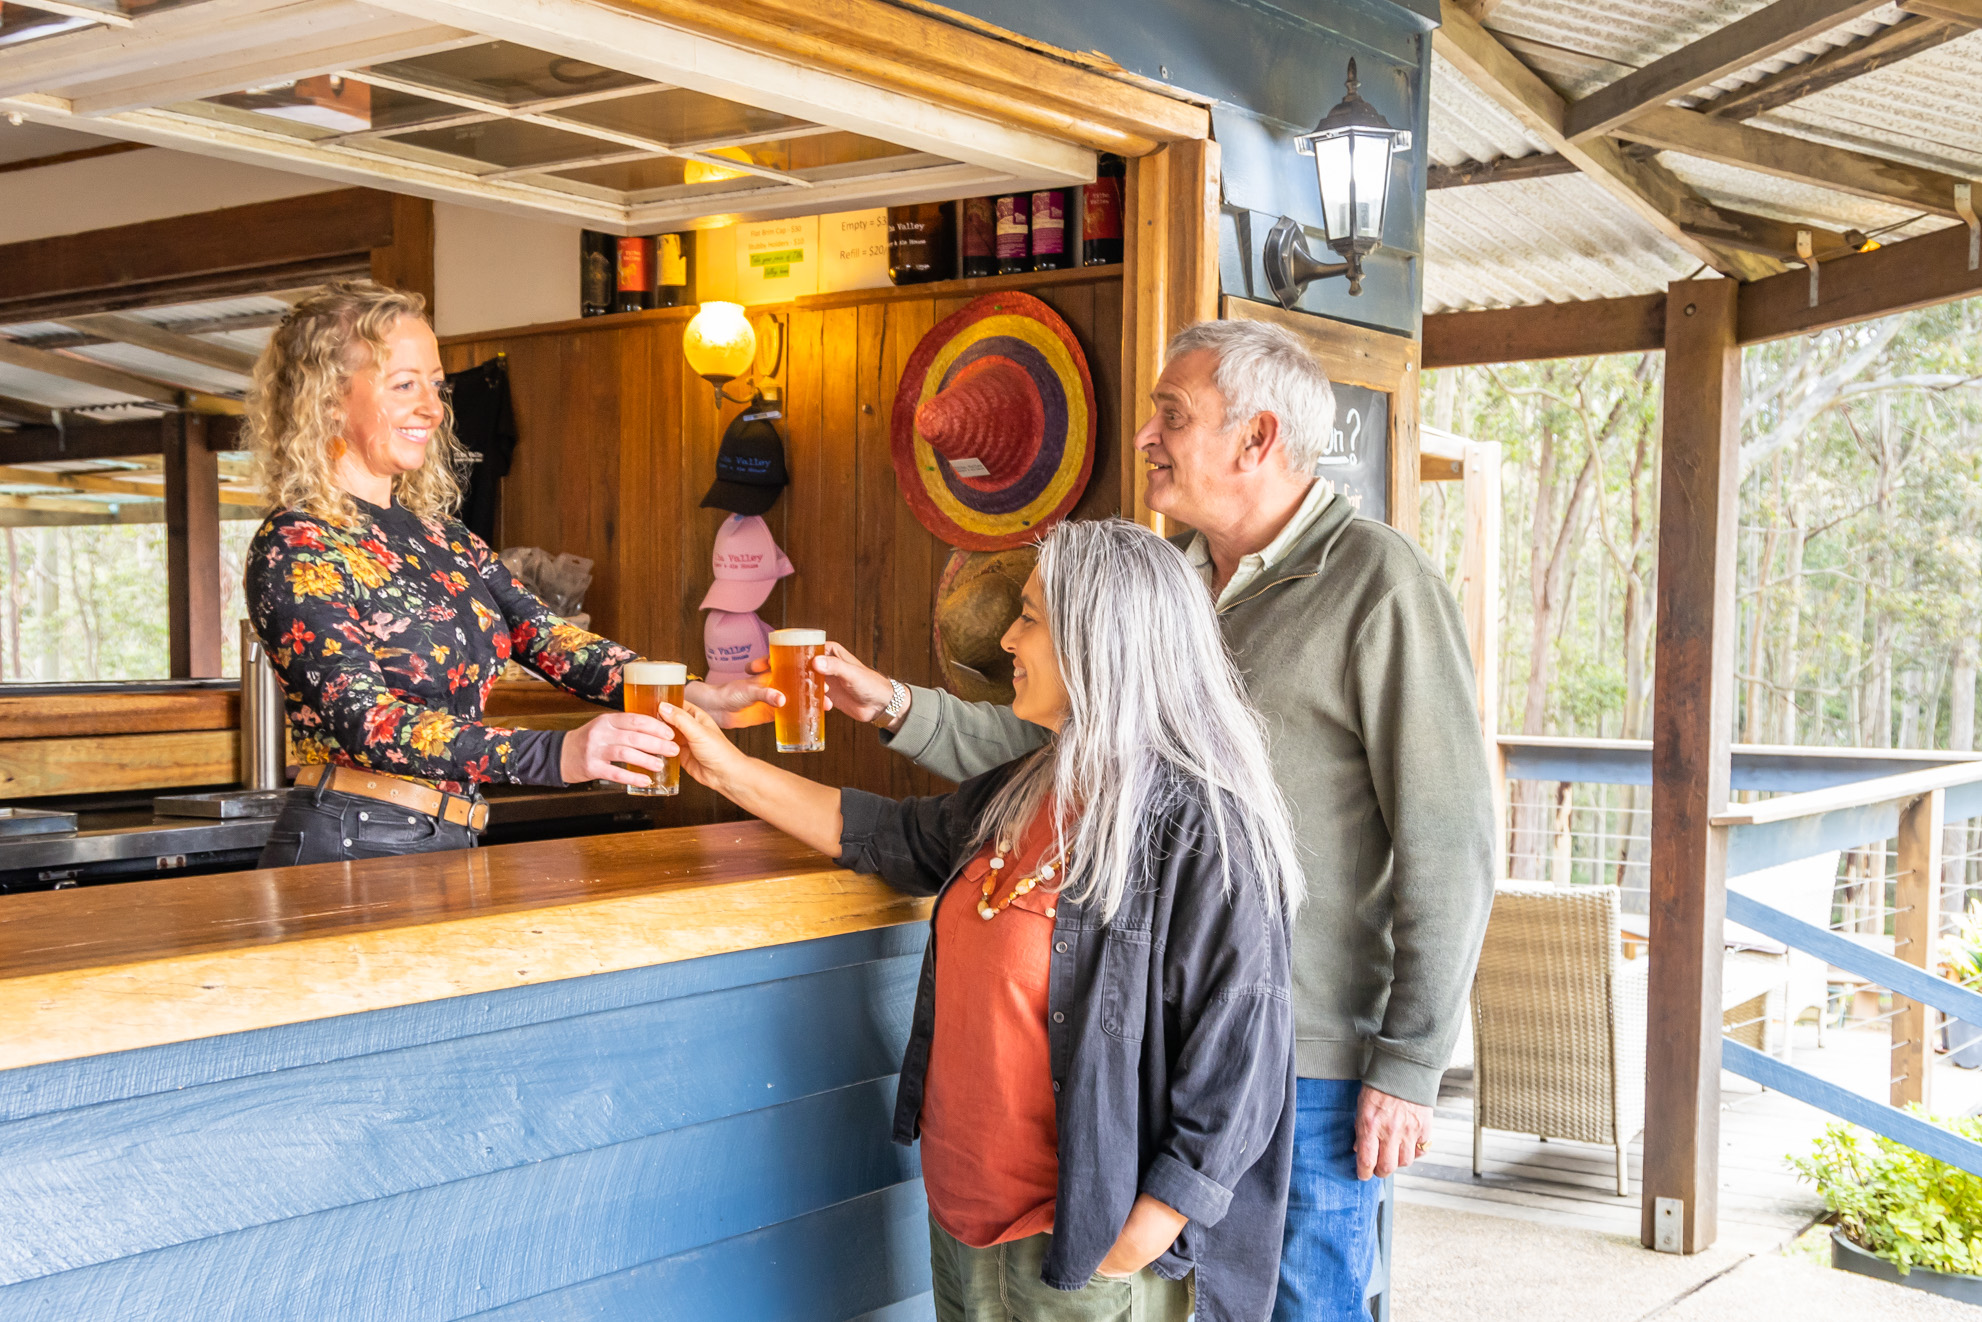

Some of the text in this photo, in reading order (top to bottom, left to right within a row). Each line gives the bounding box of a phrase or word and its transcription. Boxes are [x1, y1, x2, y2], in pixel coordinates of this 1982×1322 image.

[776, 227, 786, 235] Cap
[841, 220, 867, 232] Empty
[897, 222, 925, 232] Valley
[840, 248, 860, 260] Refill
[736, 455, 771, 468] Valley
[728, 554, 763, 563] Valley
[717, 644, 752, 655] Valley
